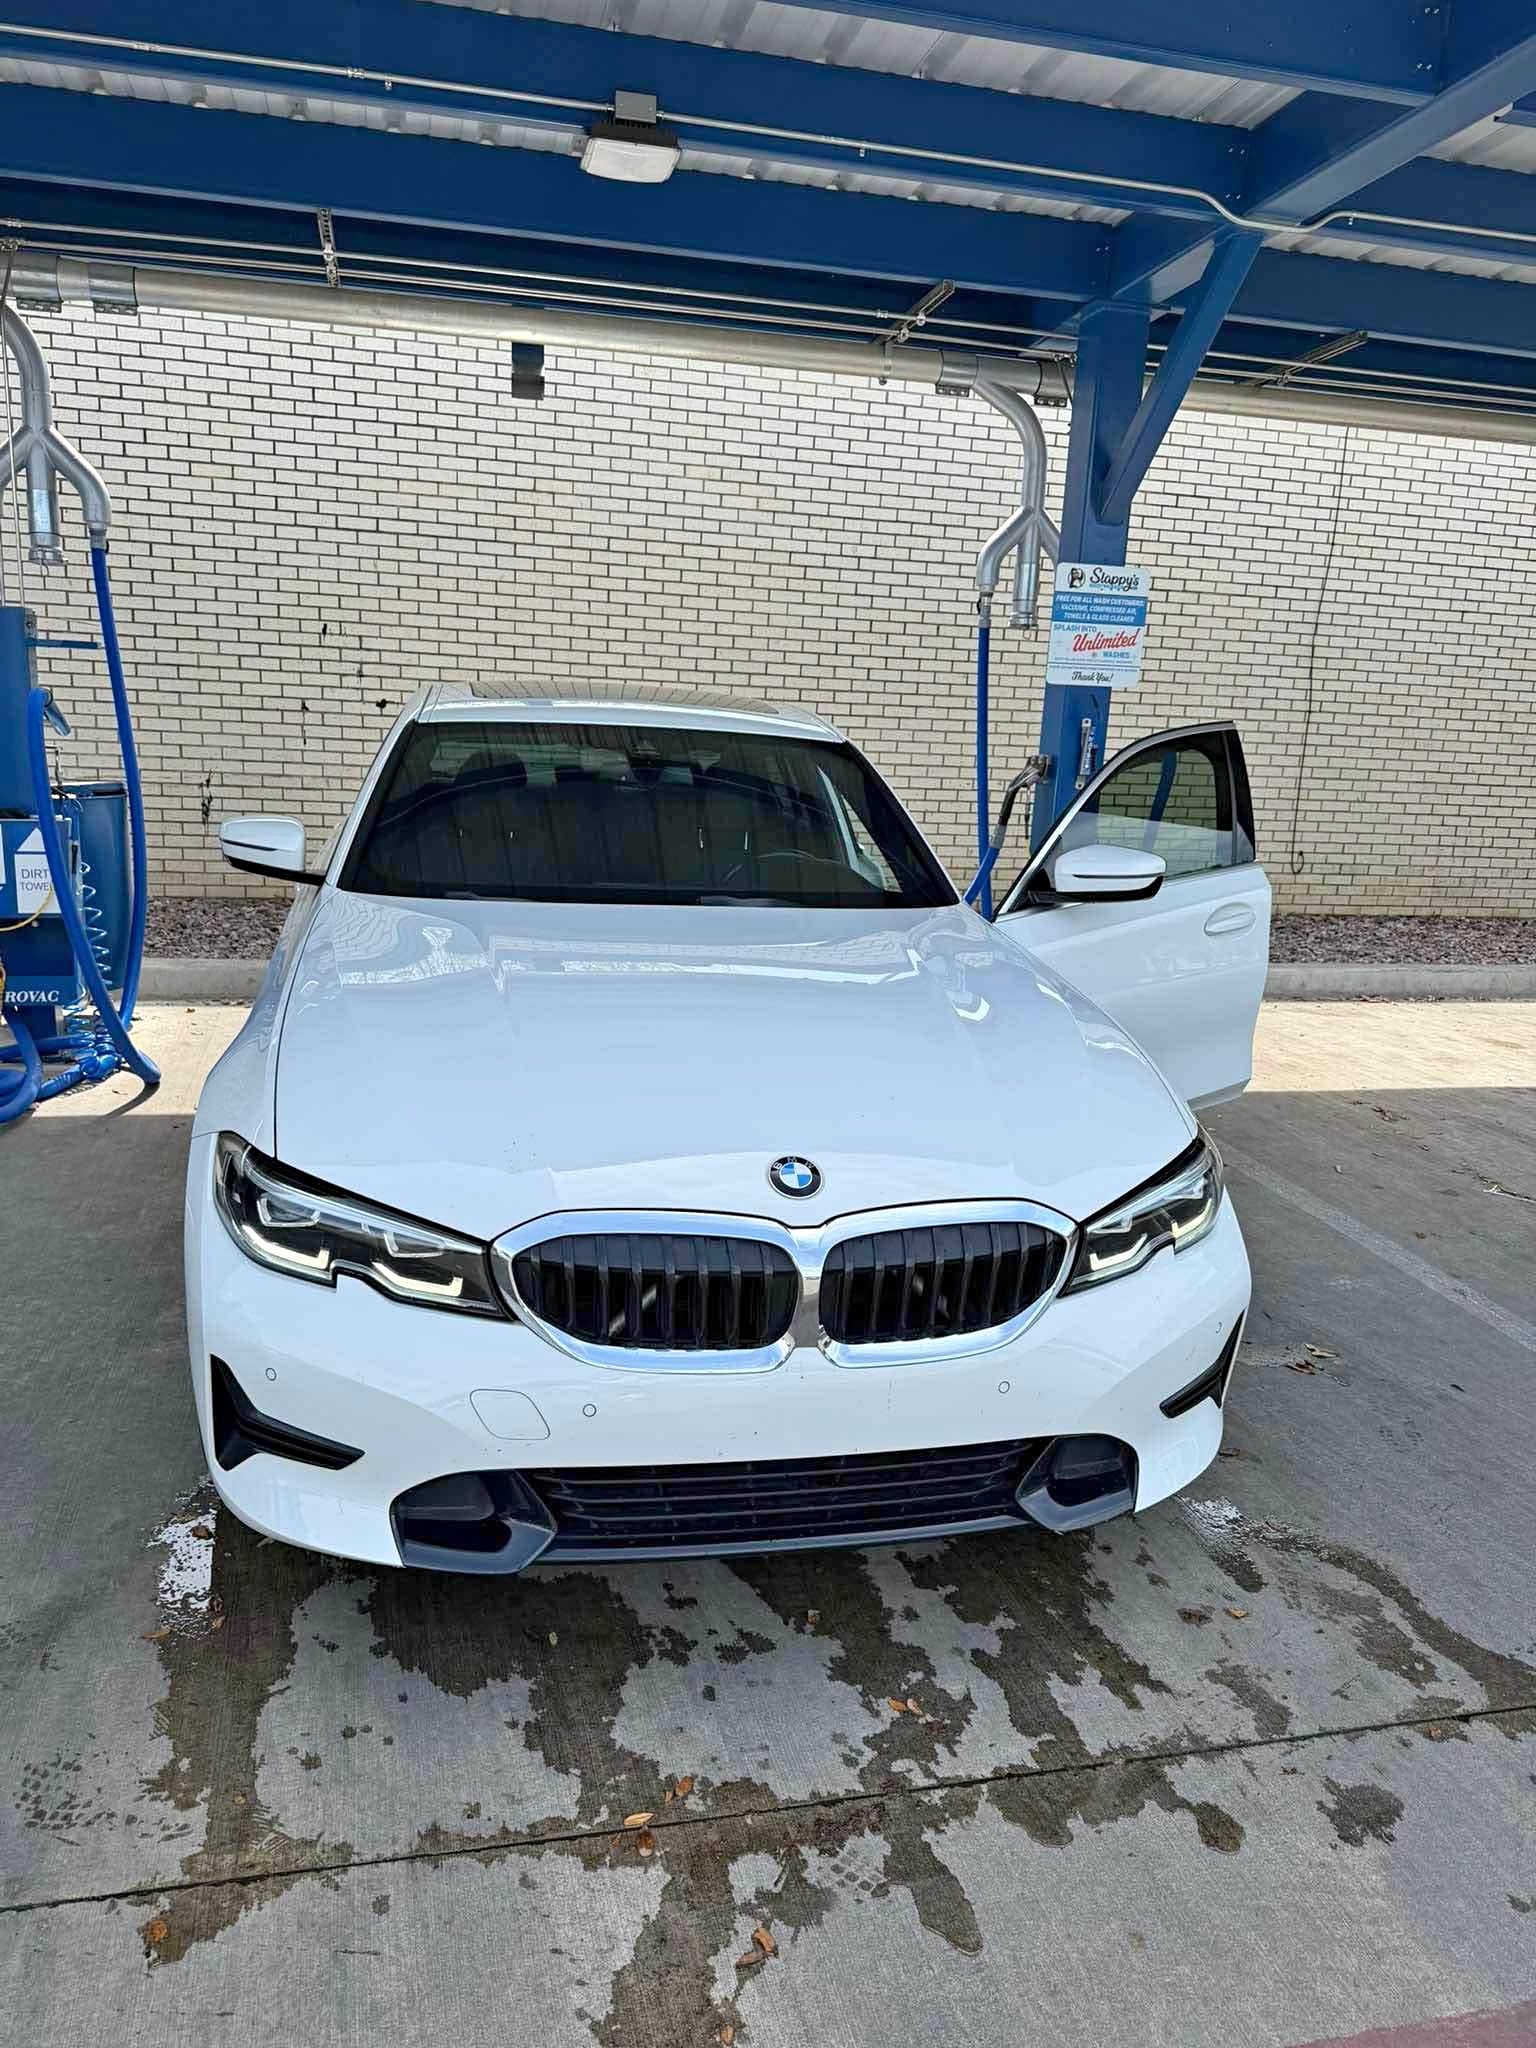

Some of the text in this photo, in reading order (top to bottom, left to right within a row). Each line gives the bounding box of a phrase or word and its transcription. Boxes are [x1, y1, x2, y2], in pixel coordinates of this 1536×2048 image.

[1089, 567, 1139, 592] Slappy's
[1055, 594, 1069, 602] FREE
[1070, 595, 1082, 603] FOR
[1089, 605, 1126, 613] COMPRESSED
[1063, 611, 1085, 619] TOWELS
[1110, 615, 1135, 623] CLEANER
[1053, 624, 1097, 633] SPLASH INTO
[1073, 628, 1141, 652] Unlimited
[1102, 651, 1130, 659] WASHES
[1071, 671, 1114, 684] Thank You!
[21, 868, 49, 879] DIRT
[20, 881, 49, 892] TOWE
[4, 990, 59, 1003] ROVAC
[773, 1156, 814, 1170] BMW
